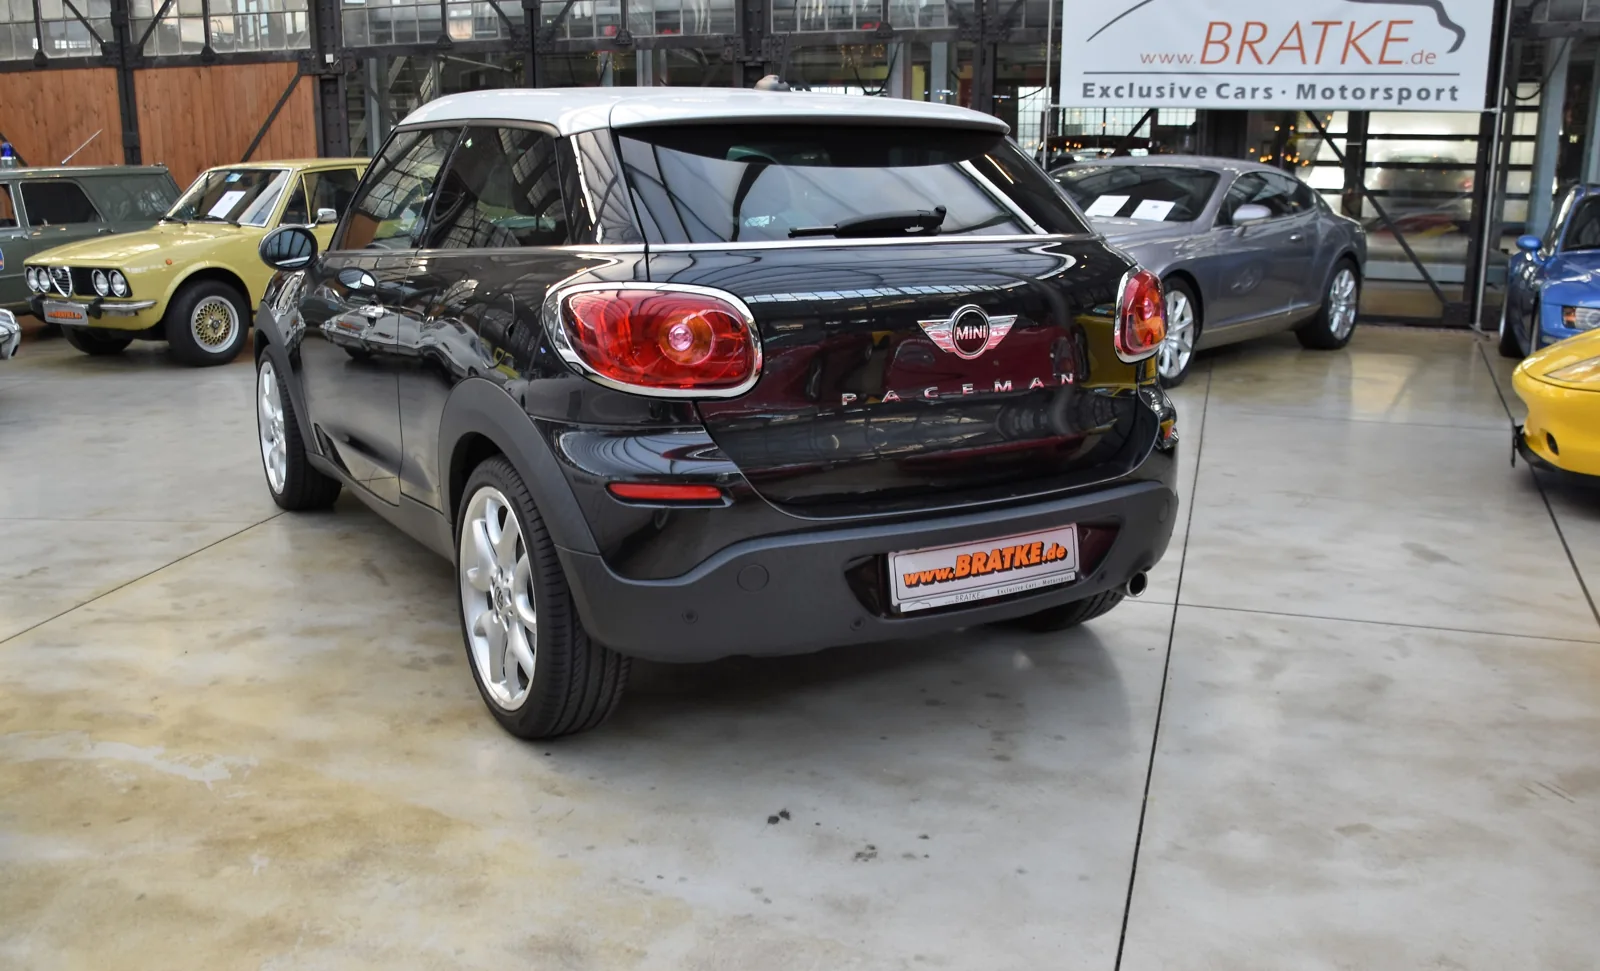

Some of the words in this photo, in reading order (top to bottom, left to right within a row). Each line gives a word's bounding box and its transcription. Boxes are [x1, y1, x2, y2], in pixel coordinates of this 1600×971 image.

[1140, 20, 1437, 65] www.BRATKE.de
[1082, 82, 1208, 99] Exclusive
[1215, 83, 1273, 100] Cars
[1296, 83, 1459, 105] Motorsport
[956, 325, 986, 340] MINI
[841, 373, 1074, 406] PACEMAN
[903, 541, 1068, 588] www.BRATKE.de
